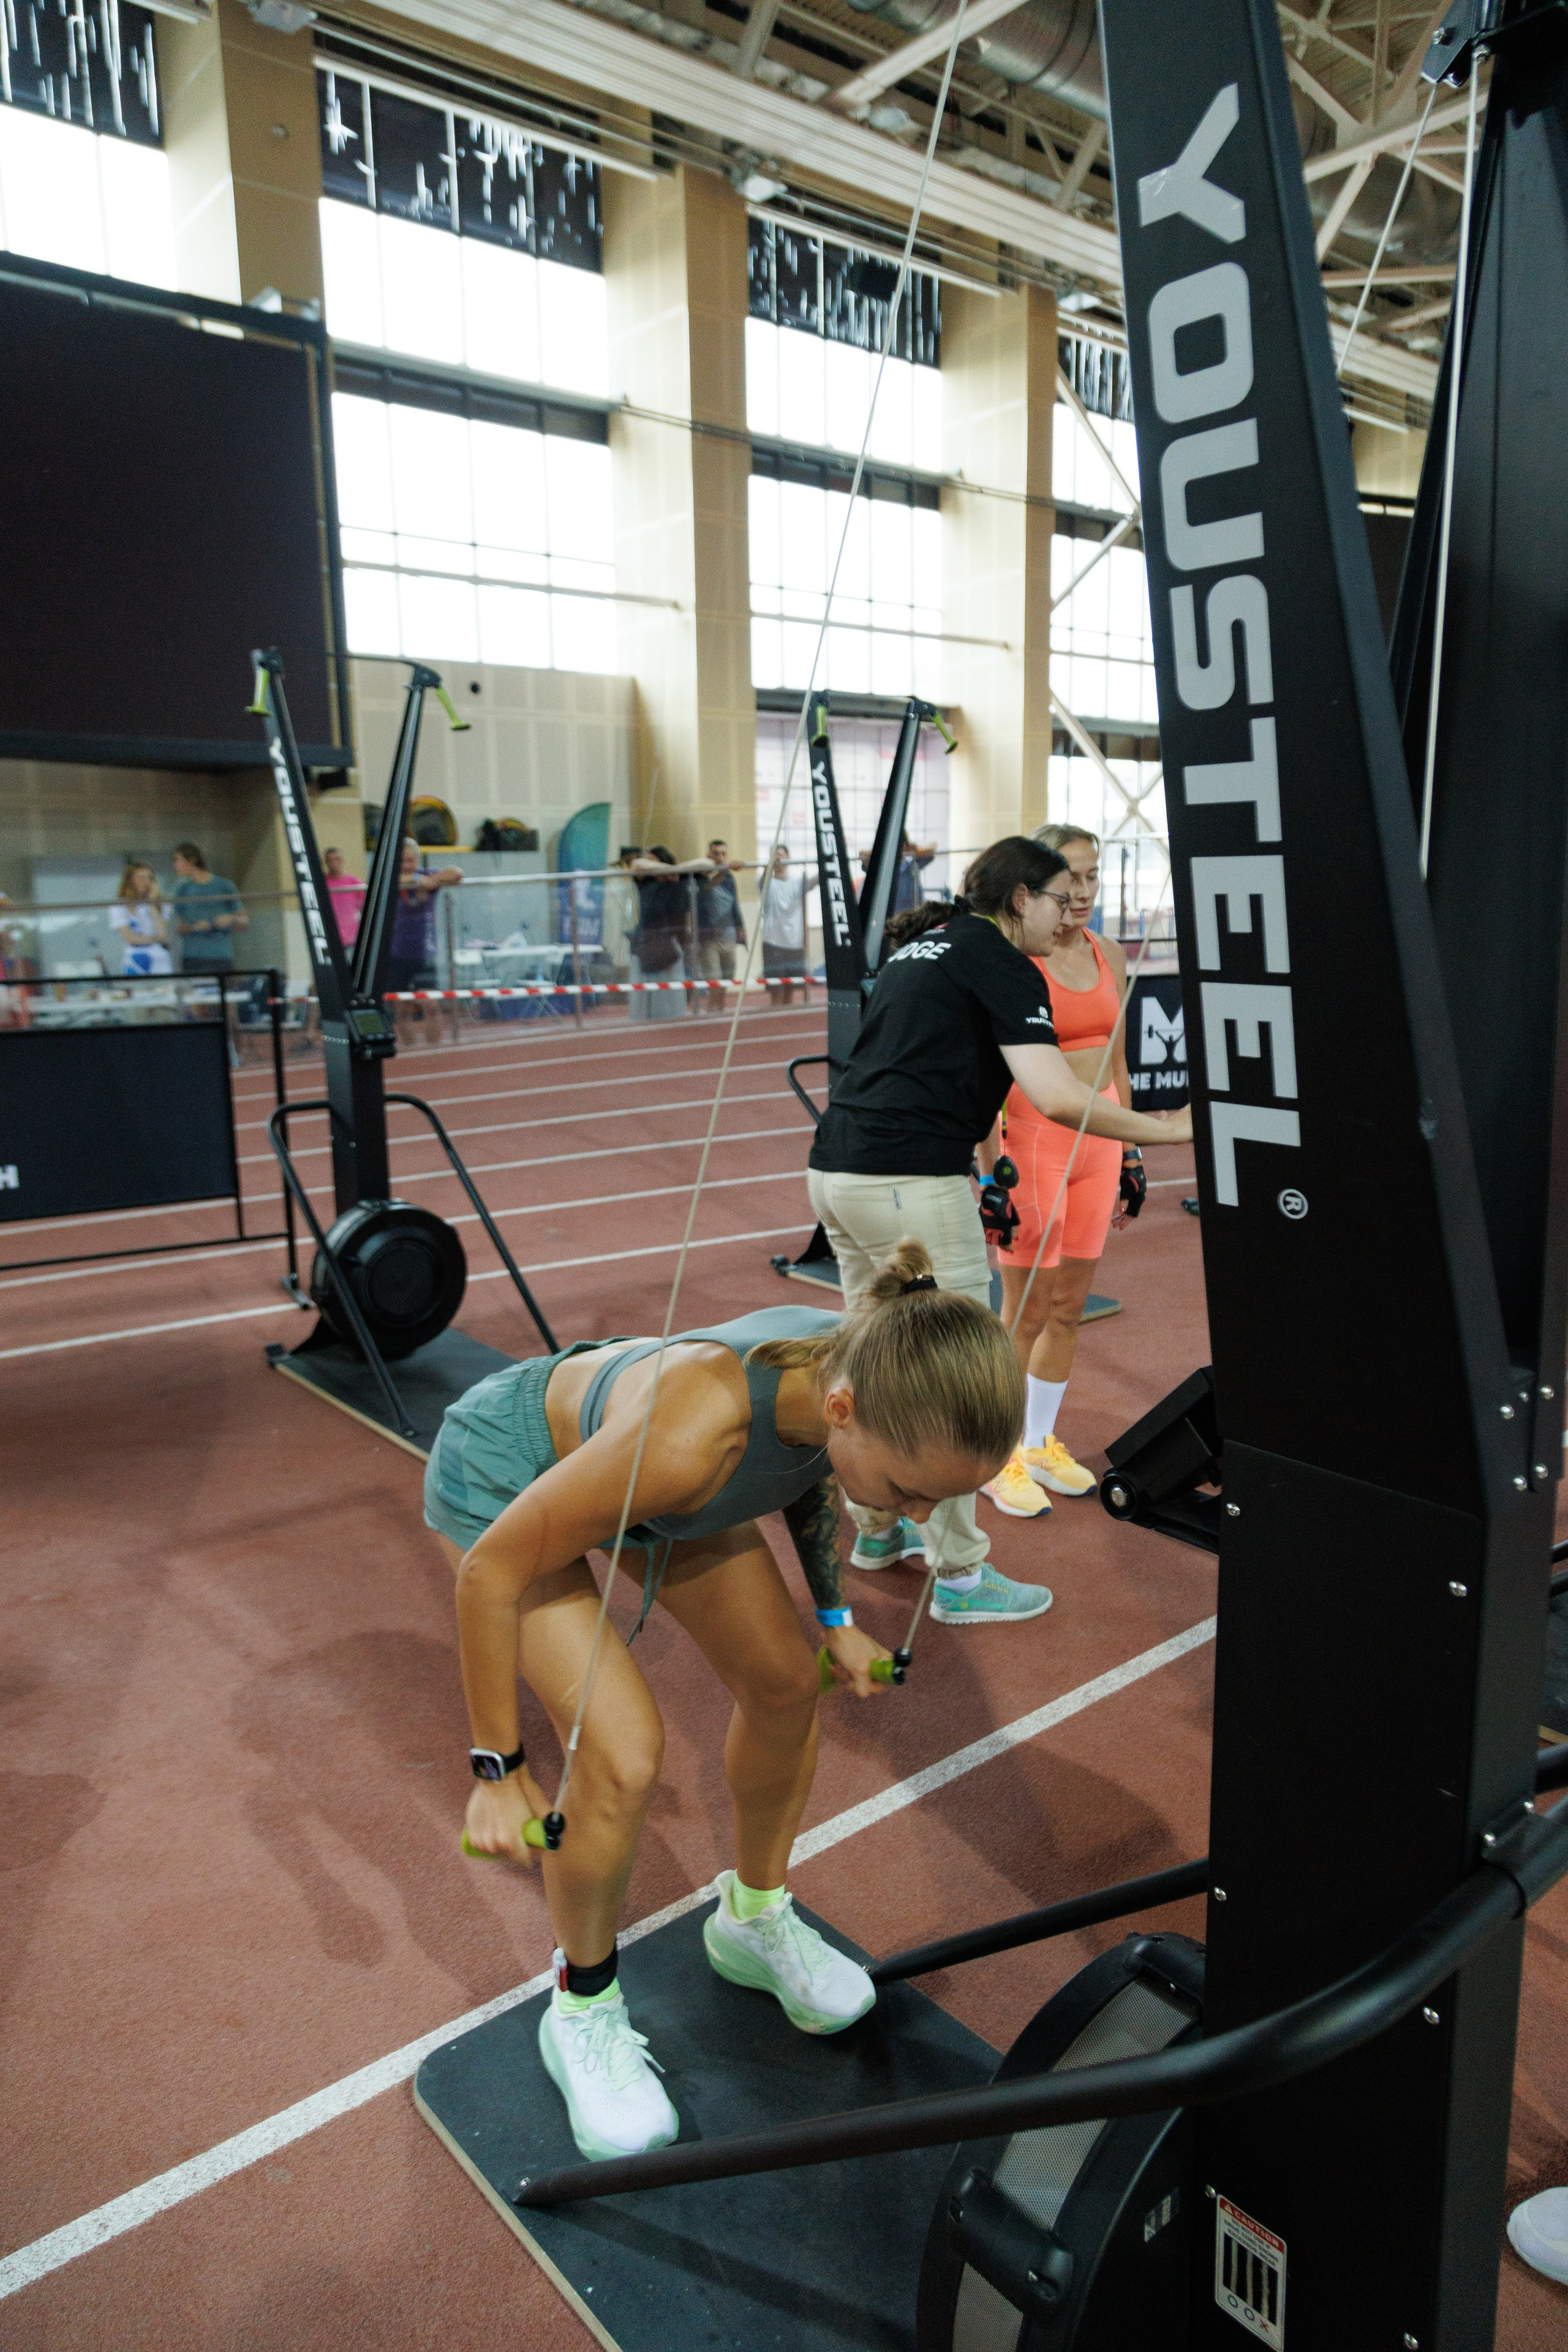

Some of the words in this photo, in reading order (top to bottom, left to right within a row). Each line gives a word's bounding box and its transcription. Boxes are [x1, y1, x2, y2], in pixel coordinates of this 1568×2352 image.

[1137, 81, 1301, 1207] YOUSTEEL
[268, 736, 328, 965] YOUSTEEL
[812, 760, 849, 946] YOUSTEEL
[1128, 1072, 1151, 1090] HE
[1235, 2210, 1280, 2248] CAUTION
